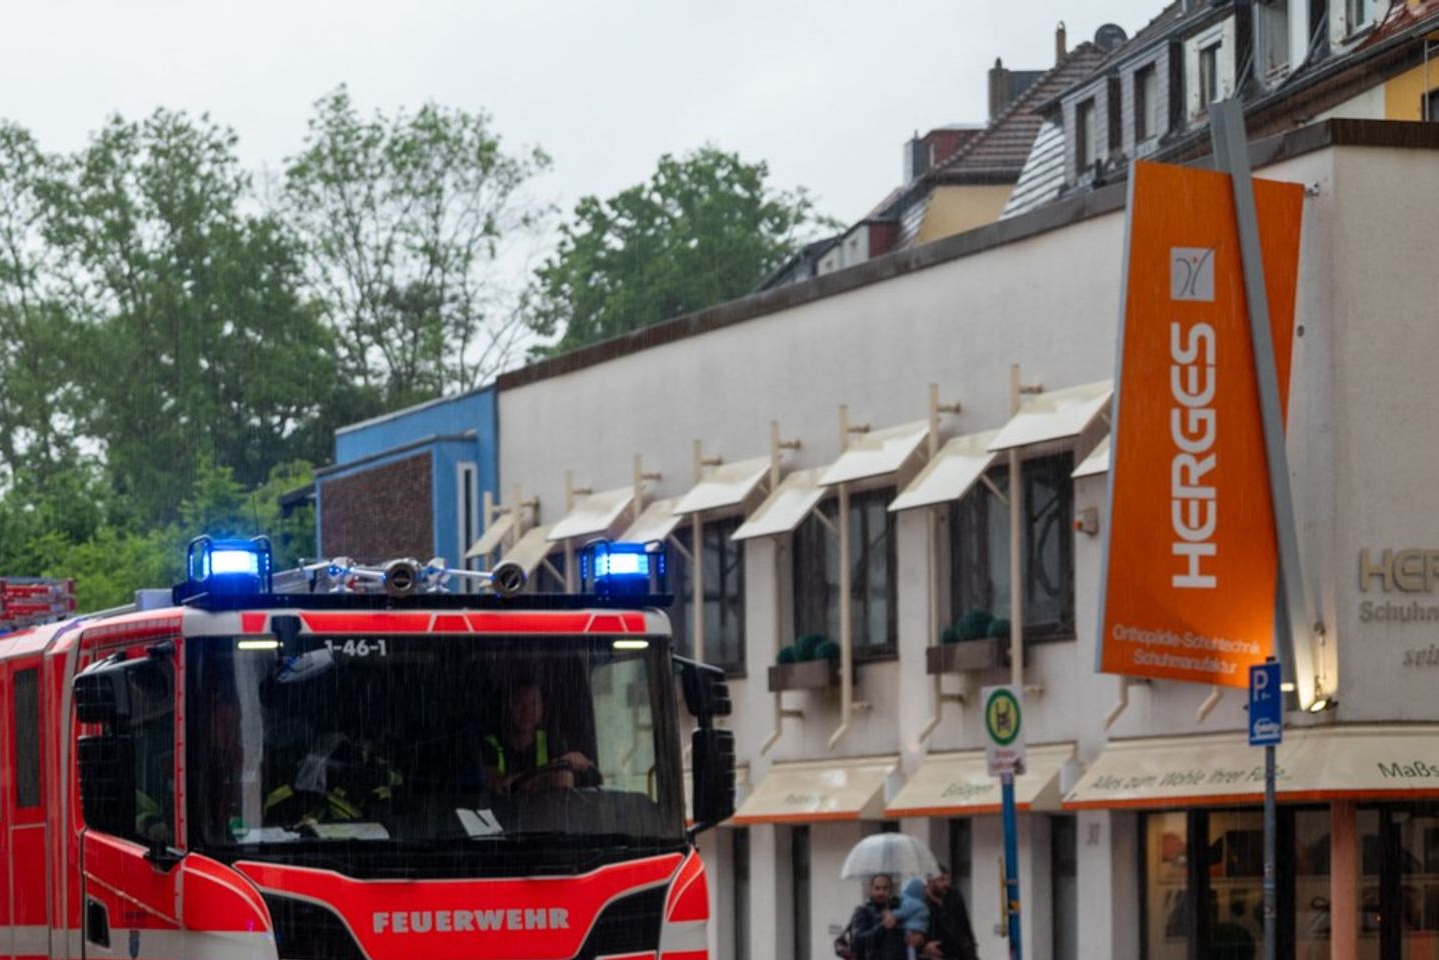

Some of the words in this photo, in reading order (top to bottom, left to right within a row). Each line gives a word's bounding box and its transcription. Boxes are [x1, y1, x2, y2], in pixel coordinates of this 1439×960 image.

[1170, 321, 1217, 588] HERGES
[1253, 669, 1269, 702] P
[1160, 770, 1205, 787] Wohle
[372, 907, 570, 934] FEUERWEHR
